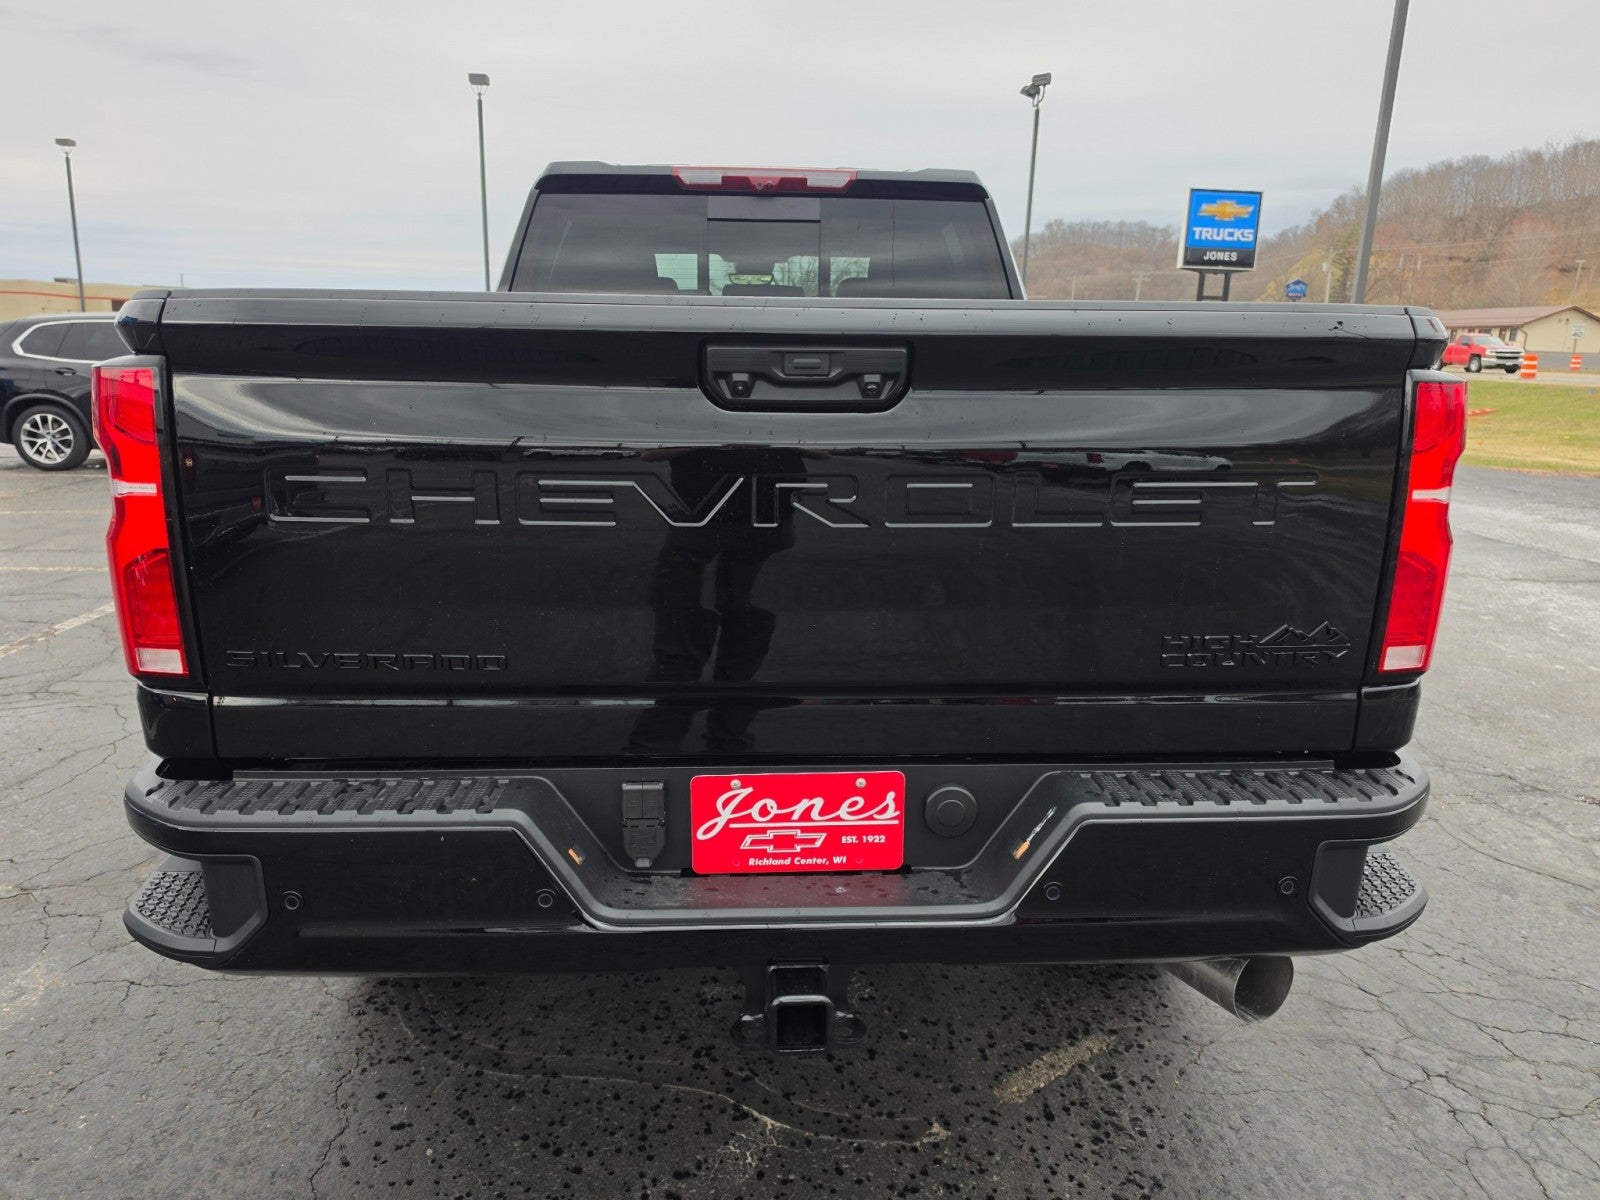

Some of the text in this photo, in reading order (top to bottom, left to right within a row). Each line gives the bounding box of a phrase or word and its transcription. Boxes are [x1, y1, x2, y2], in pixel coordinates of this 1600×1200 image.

[1193, 227, 1254, 241] TRUCKS
[1203, 251, 1238, 261] JONES
[264, 467, 1319, 528] CHEVROLET
[1161, 635, 1260, 650] HIGH
[225, 650, 508, 671] SILVERADO
[1160, 650, 1349, 668] COUNTRY
[696, 787, 900, 841] Jones
[841, 835, 886, 844] EST. 1922
[748, 856, 847, 866] Richland Center, WI
